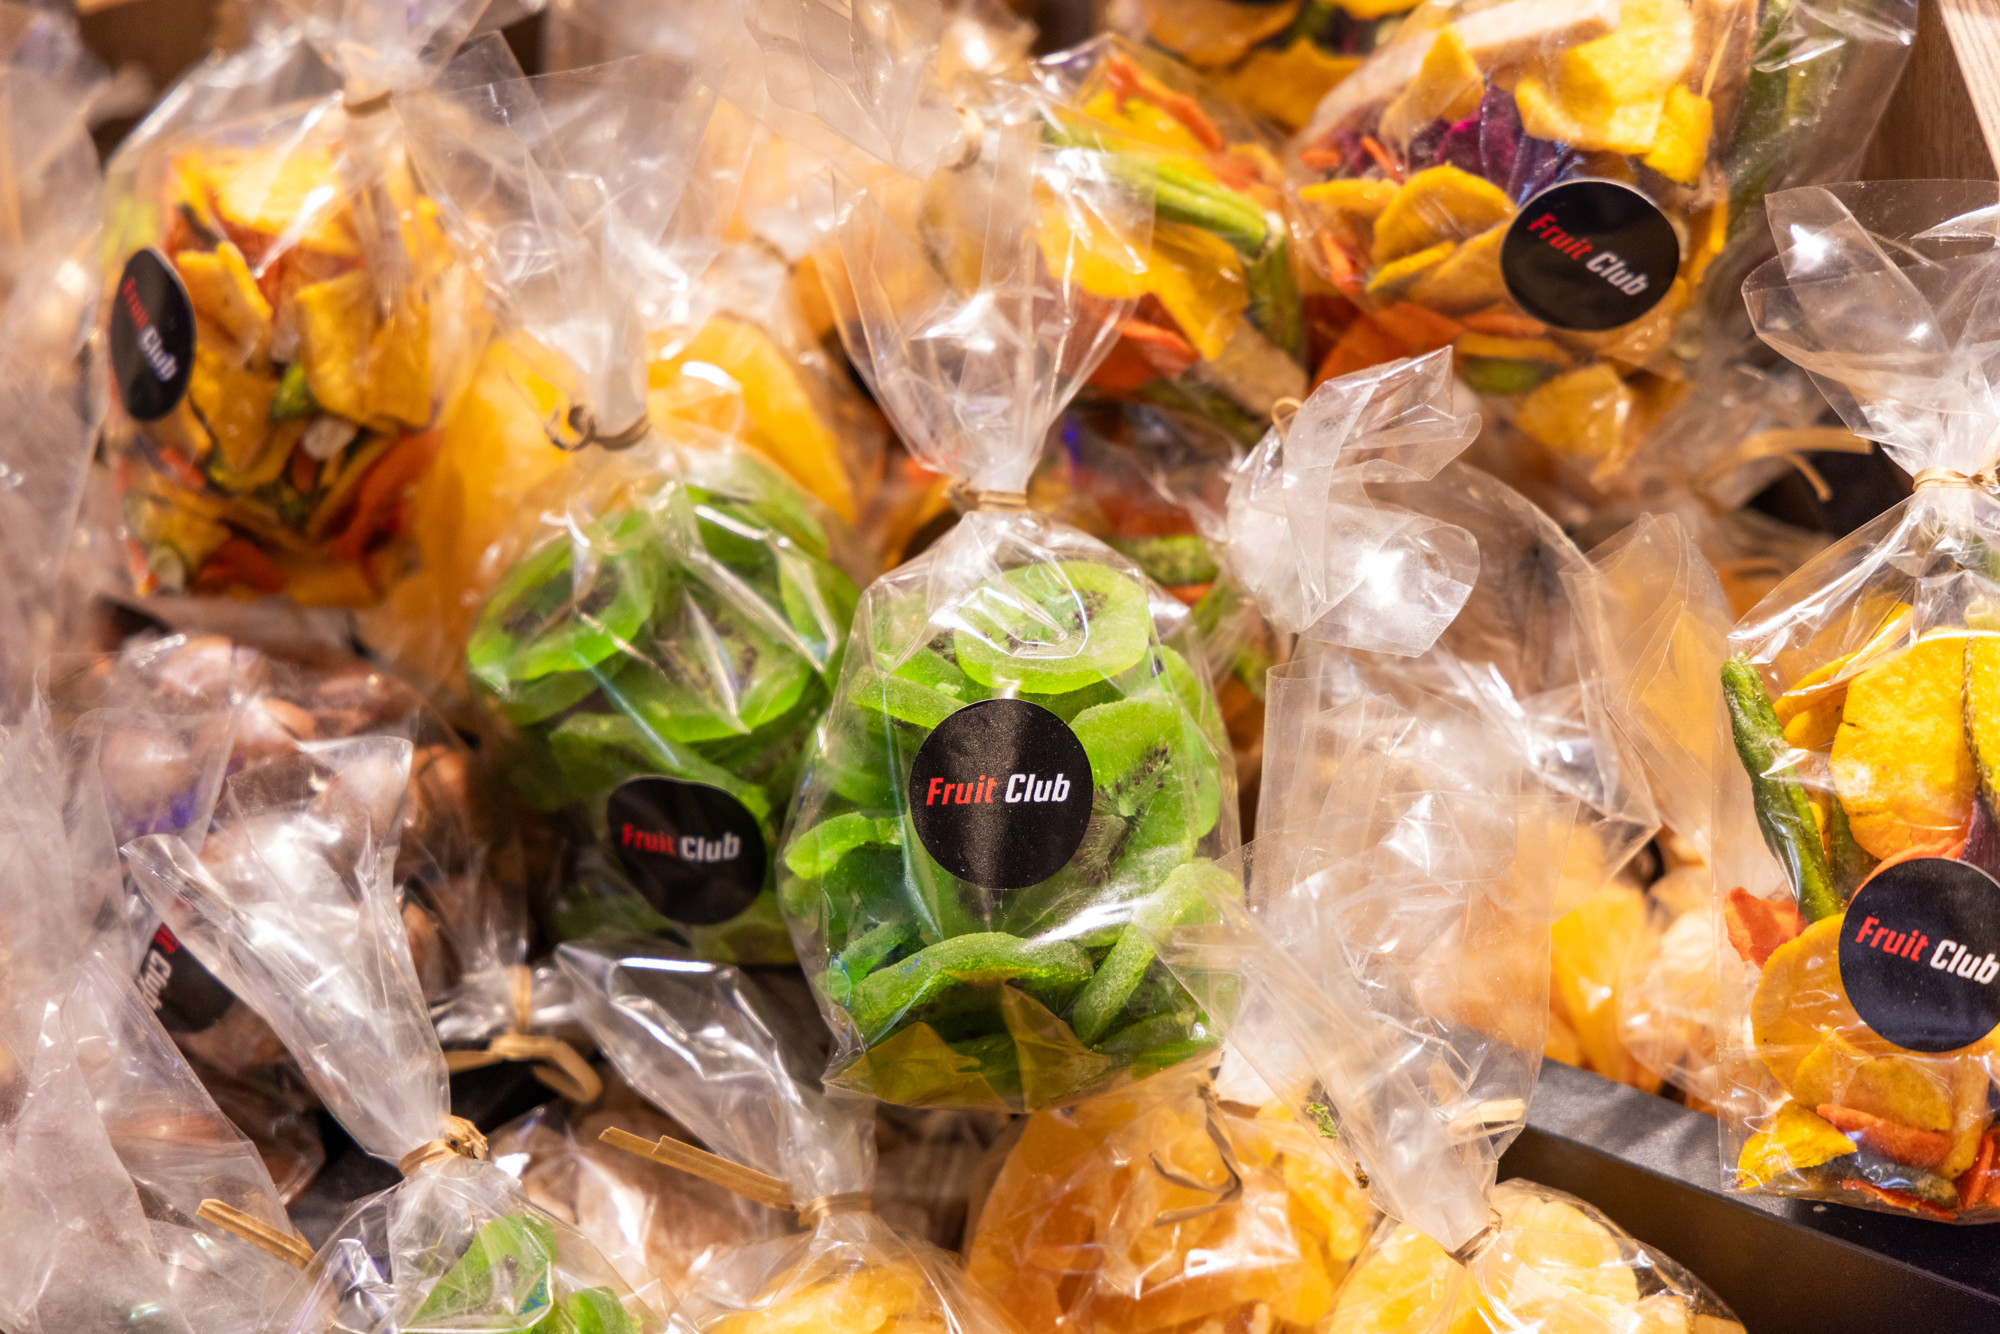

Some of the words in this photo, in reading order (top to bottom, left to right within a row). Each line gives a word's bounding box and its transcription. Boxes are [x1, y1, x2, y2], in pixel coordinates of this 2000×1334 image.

[1527, 213, 1593, 260] Fruit
[1585, 251, 1648, 296] Club
[138, 323, 177, 381] Club
[926, 774, 998, 806] Fruit
[1004, 773, 1071, 803] Club
[622, 823, 676, 856] Fruit
[680, 831, 741, 863] Club
[1855, 915, 1929, 962] Fruit
[1929, 939, 2000, 984] Club
